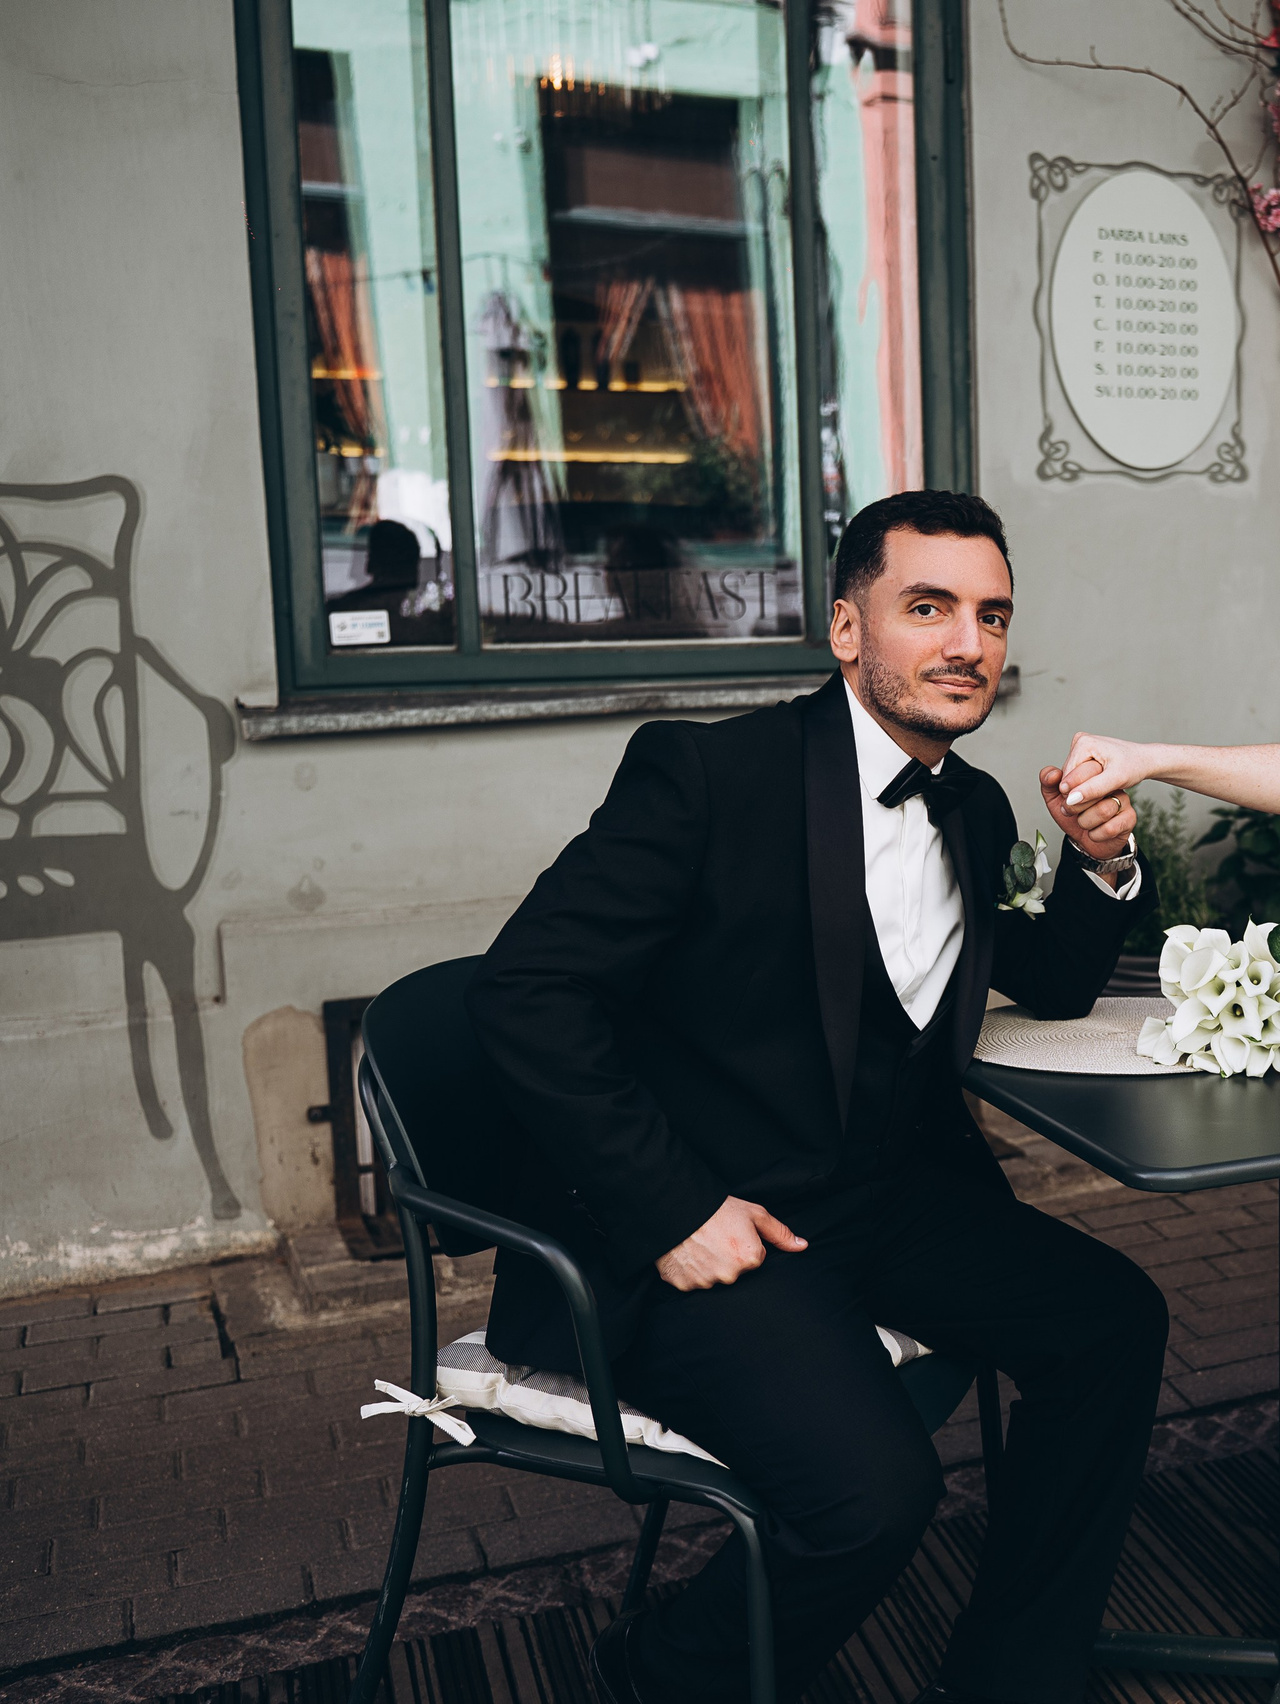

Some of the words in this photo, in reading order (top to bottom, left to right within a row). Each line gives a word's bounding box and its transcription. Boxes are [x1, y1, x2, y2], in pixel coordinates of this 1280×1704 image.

[1098, 227, 1145, 243] DARBA
[1148, 231, 1189, 246] LAIKS
[501, 568, 777, 624] BREAKFAST
